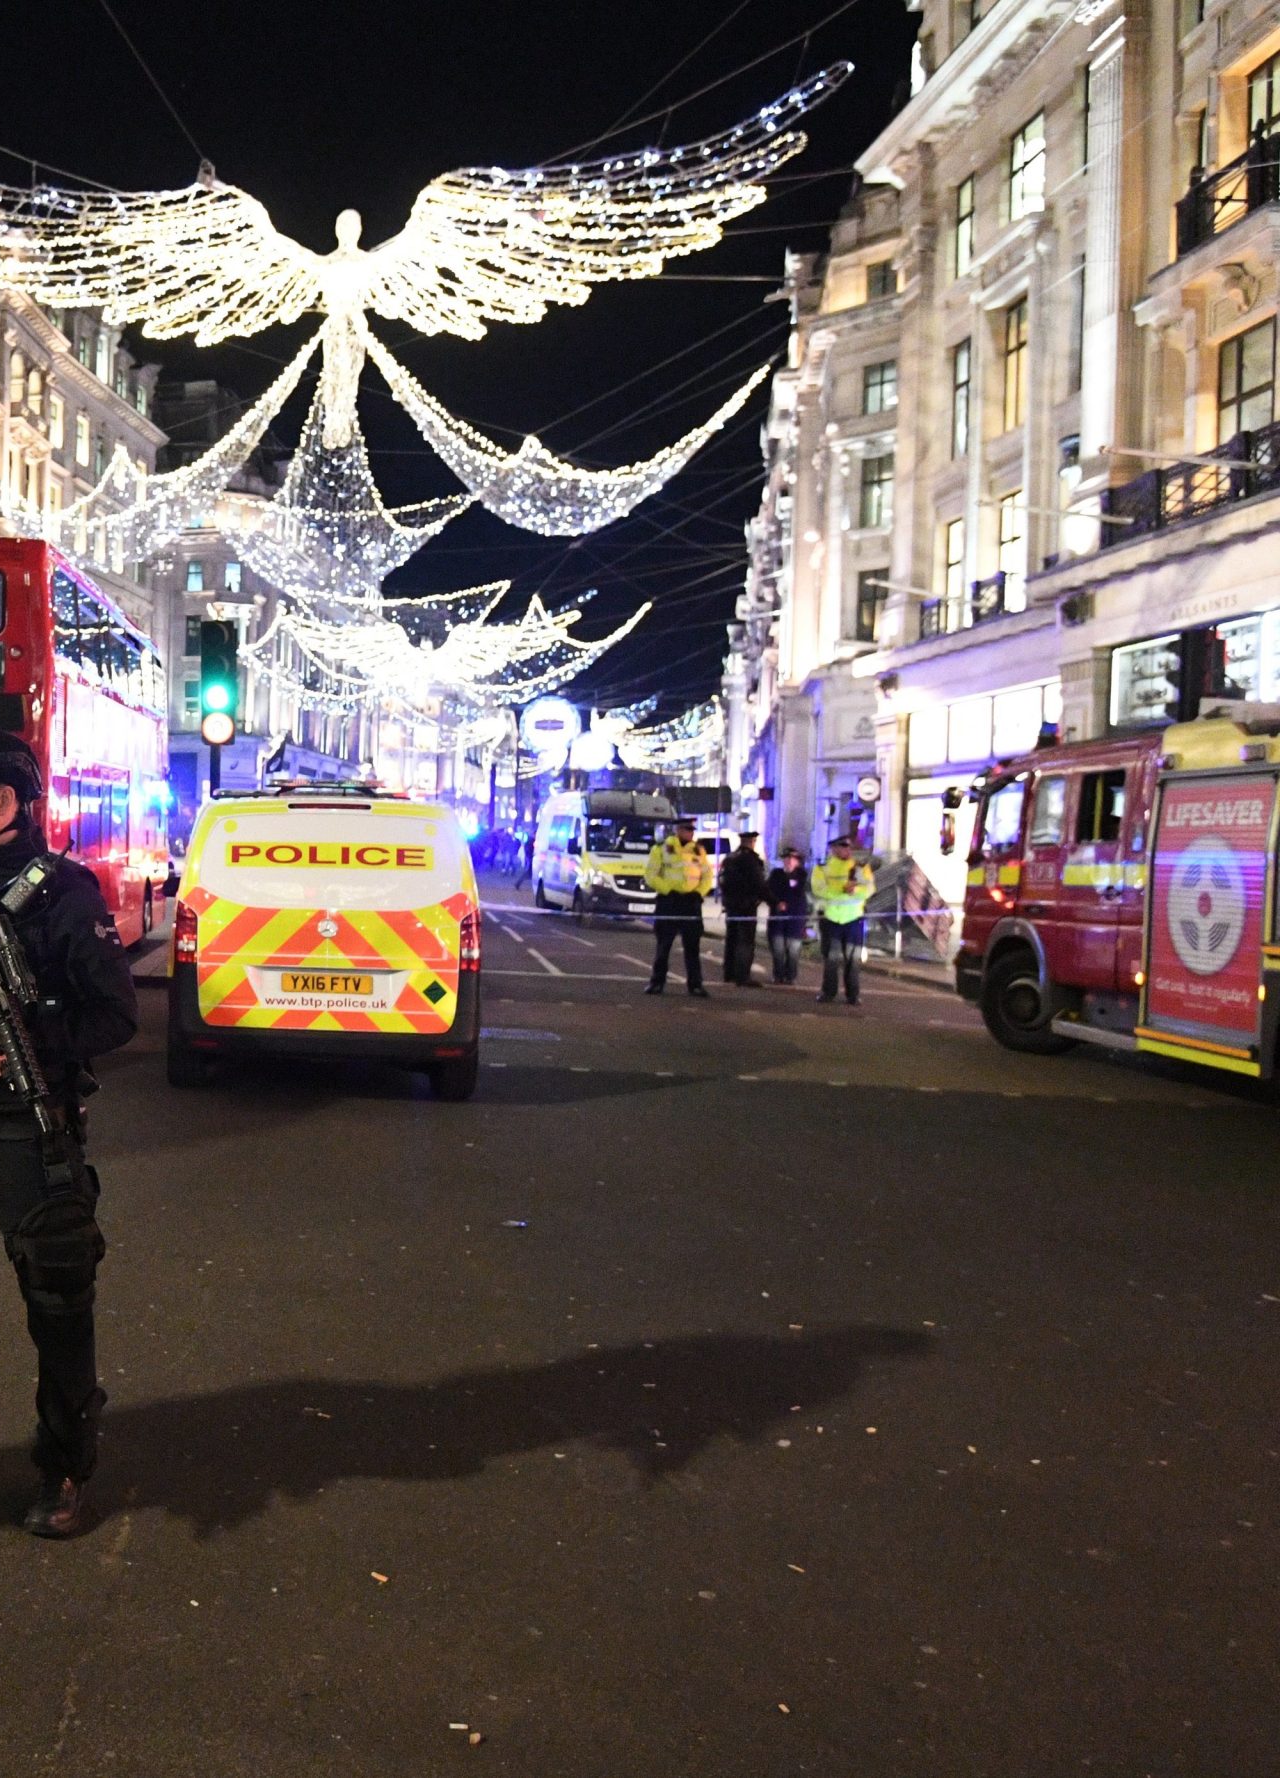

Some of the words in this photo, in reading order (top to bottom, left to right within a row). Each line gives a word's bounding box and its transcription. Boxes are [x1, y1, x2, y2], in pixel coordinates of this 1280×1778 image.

[1166, 801, 1263, 826] LIFESAVER
[231, 845, 426, 867] POLICE
[291, 975, 325, 991] YX16
[330, 977, 362, 992] FTV
[265, 997, 387, 1009] www.btp.police.uk
